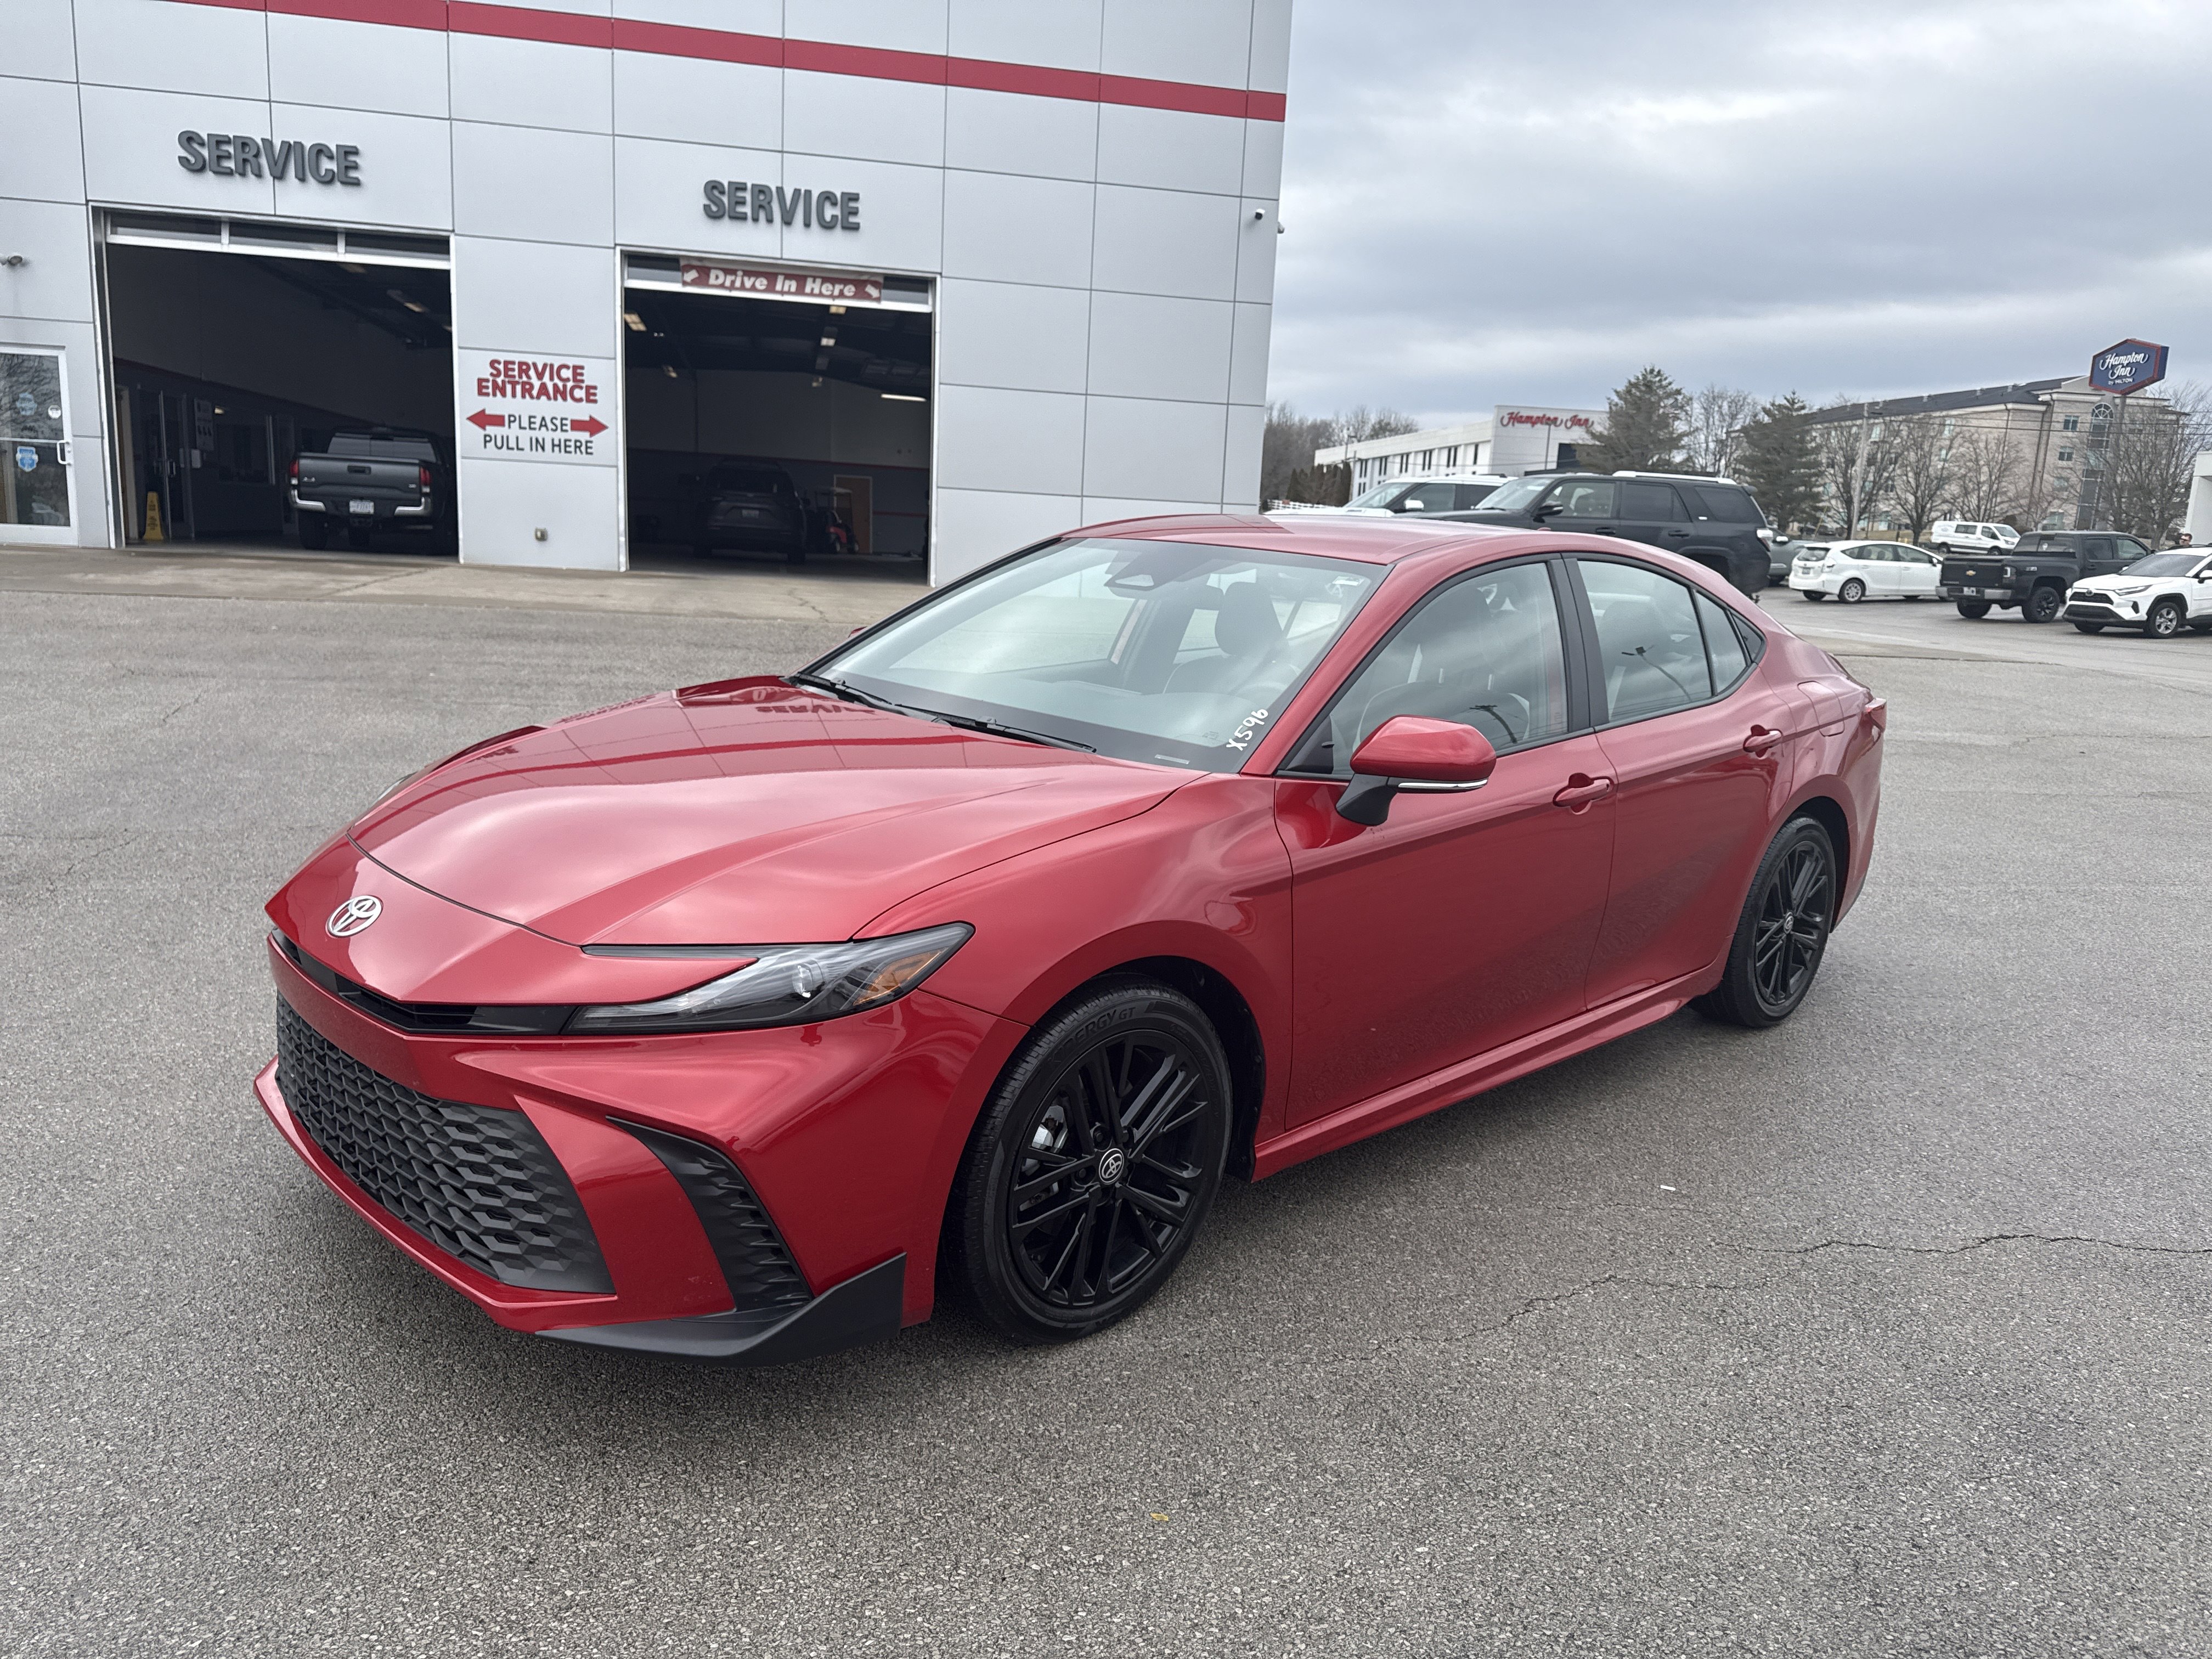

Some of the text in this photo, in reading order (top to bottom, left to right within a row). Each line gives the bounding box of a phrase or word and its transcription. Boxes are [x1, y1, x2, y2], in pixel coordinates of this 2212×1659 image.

[178, 129, 361, 186] SERVICE
[703, 179, 861, 230] SERVICE
[708, 269, 856, 296] Drive In Here
[489, 359, 585, 384] SERVICE
[2099, 352, 2148, 370] Hampton
[2108, 365, 2135, 379] Inn
[477, 378, 598, 404] ENTRANCE
[507, 415, 568, 432] PLEASE
[1500, 411, 1594, 430] Hampton Inn
[483, 434, 594, 455] PULL IN HERE
[1226, 709, 1268, 751] X596
